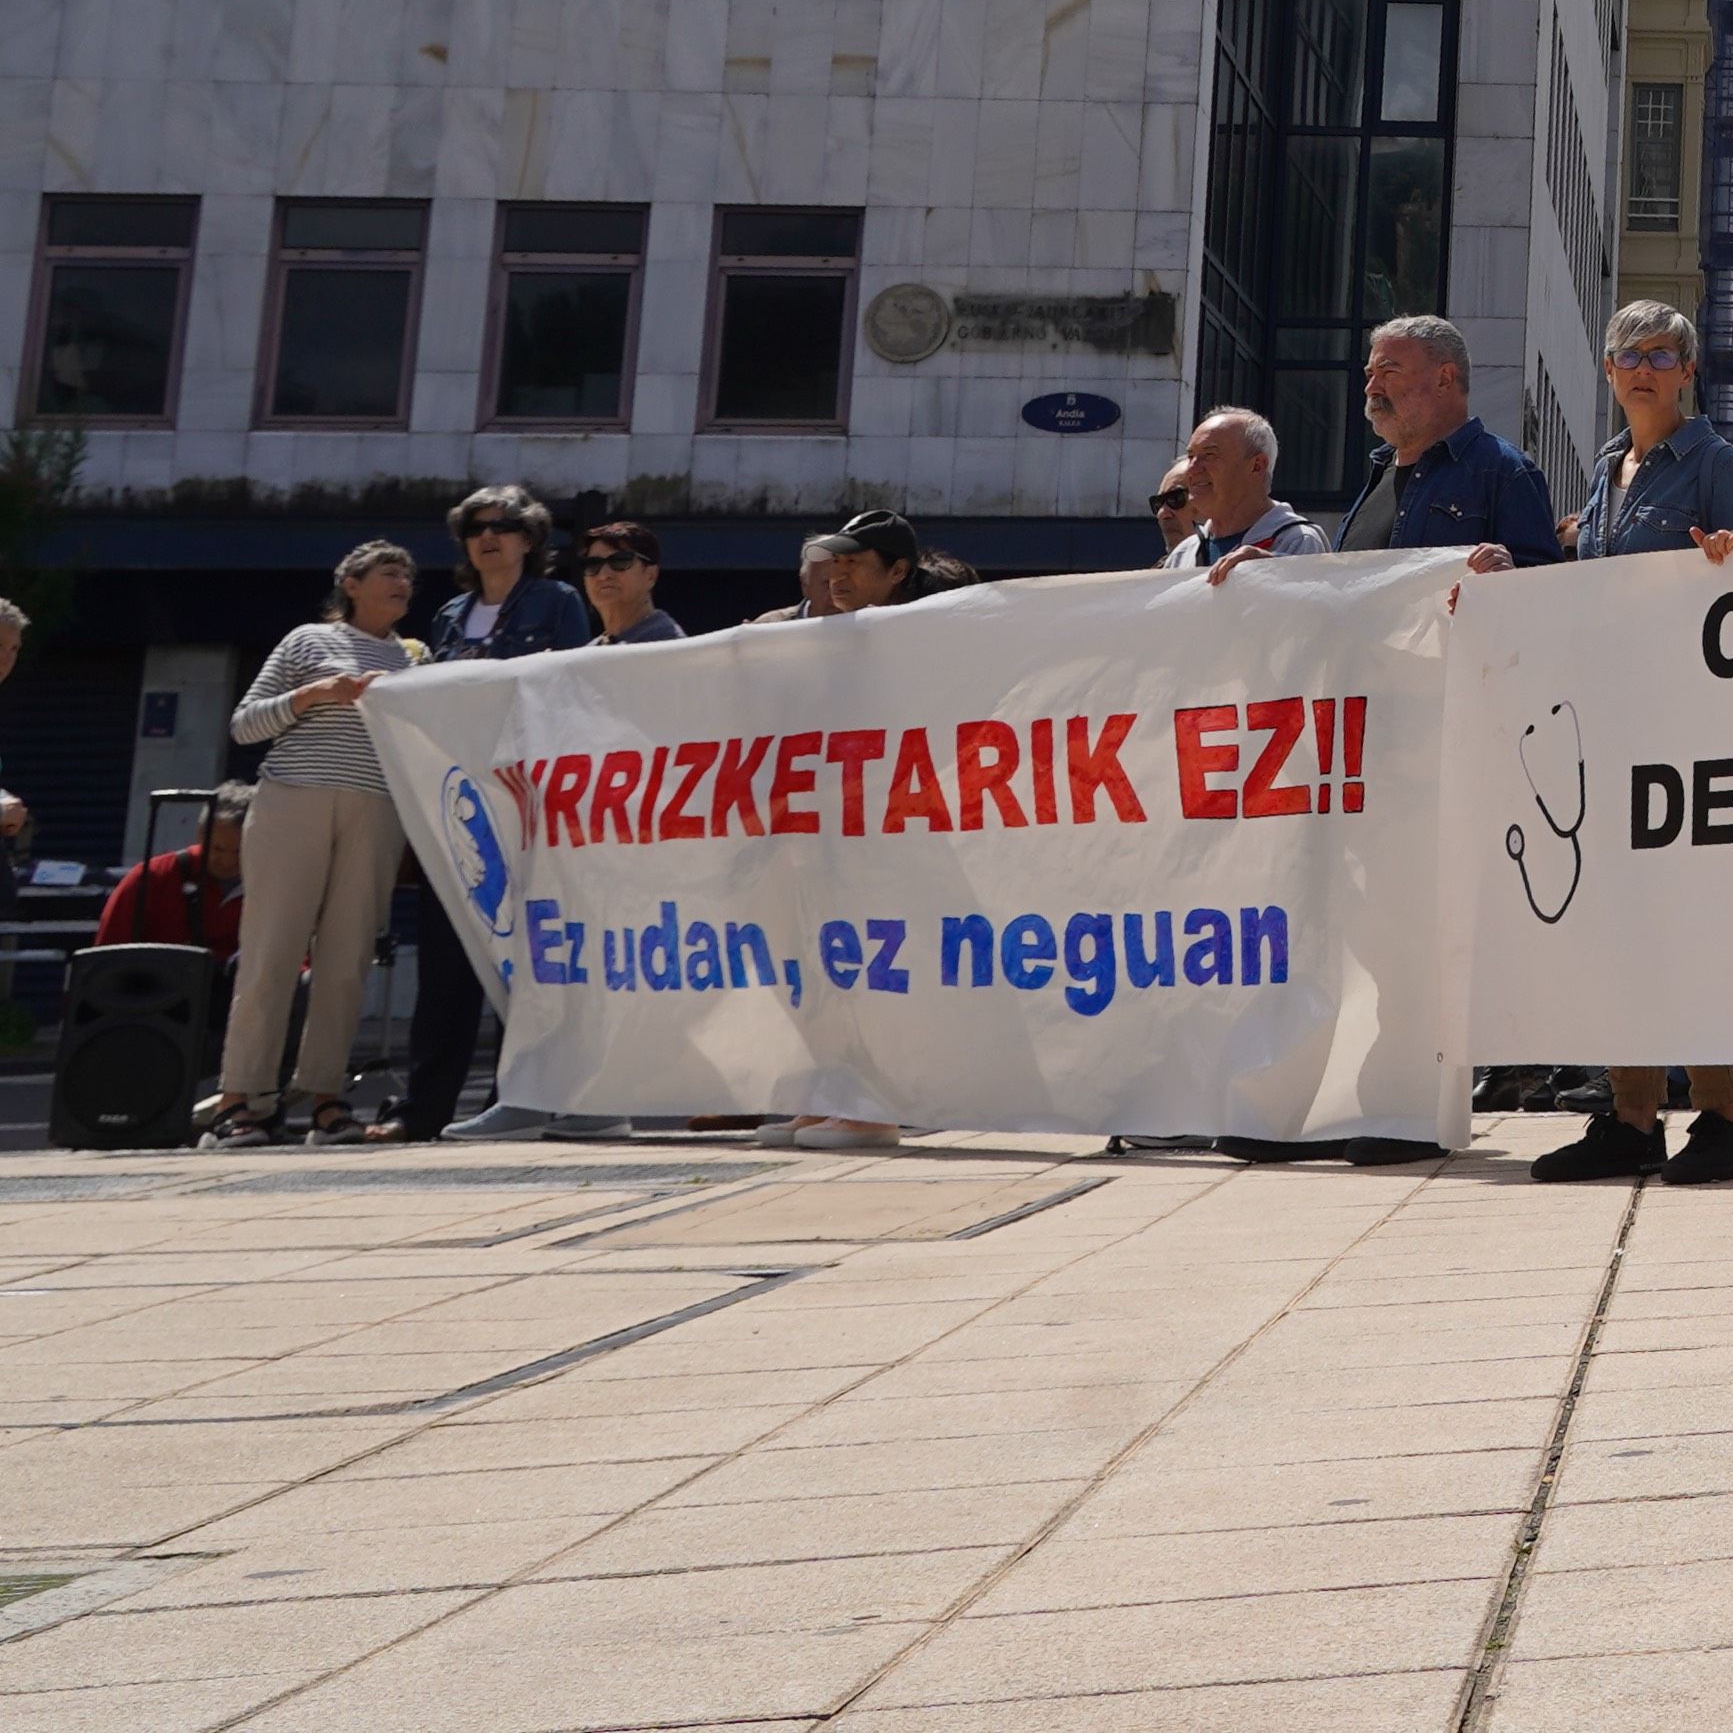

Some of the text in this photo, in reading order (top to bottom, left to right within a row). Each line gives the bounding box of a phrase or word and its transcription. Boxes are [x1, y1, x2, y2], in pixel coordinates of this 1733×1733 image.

[1173, 695, 1367, 820] EZ!!
[525, 898, 1290, 1017] Ez udan, ez neguan
